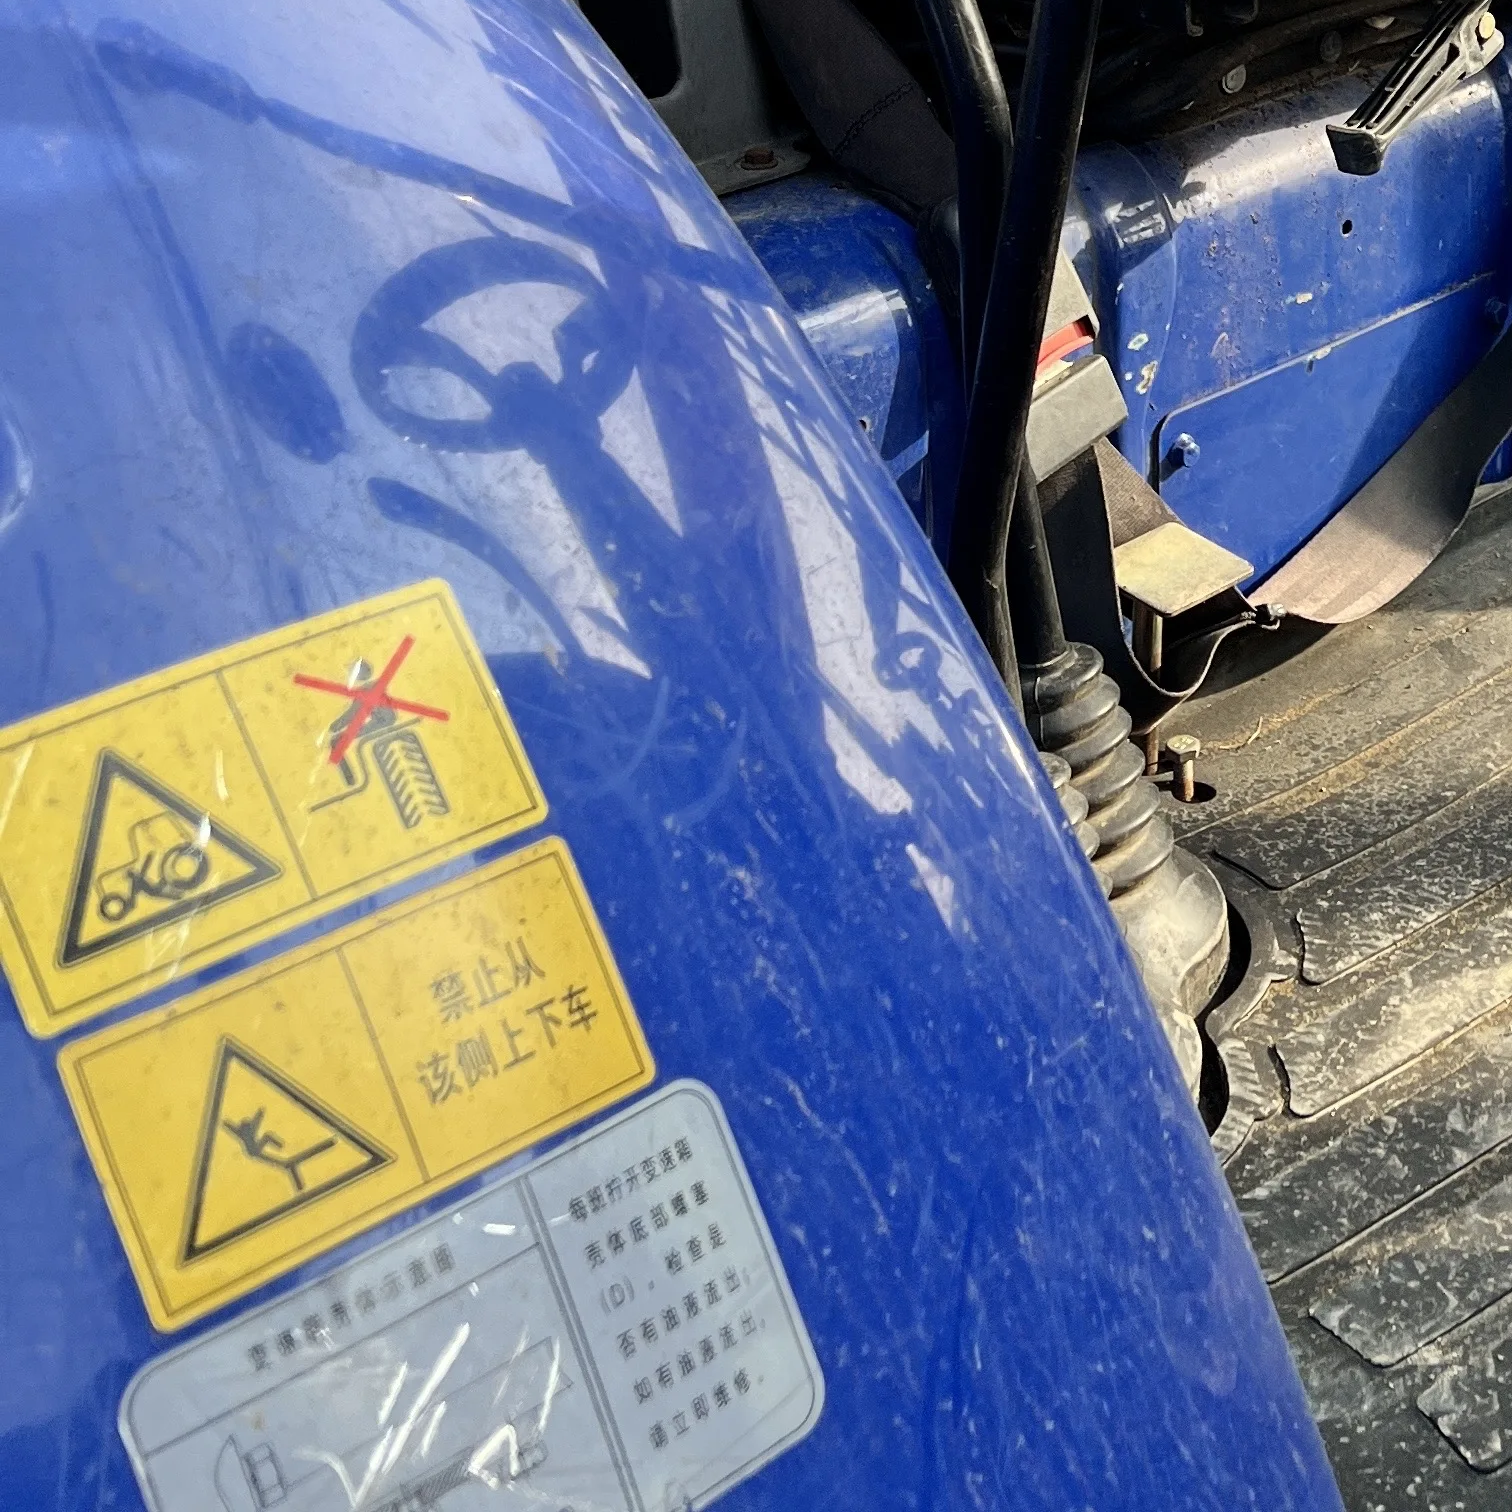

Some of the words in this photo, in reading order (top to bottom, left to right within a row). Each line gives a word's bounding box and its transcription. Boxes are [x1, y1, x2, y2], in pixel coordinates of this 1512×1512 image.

[429, 935, 546, 1024] 禁止从
[415, 984, 599, 1108] 该侧上下车
